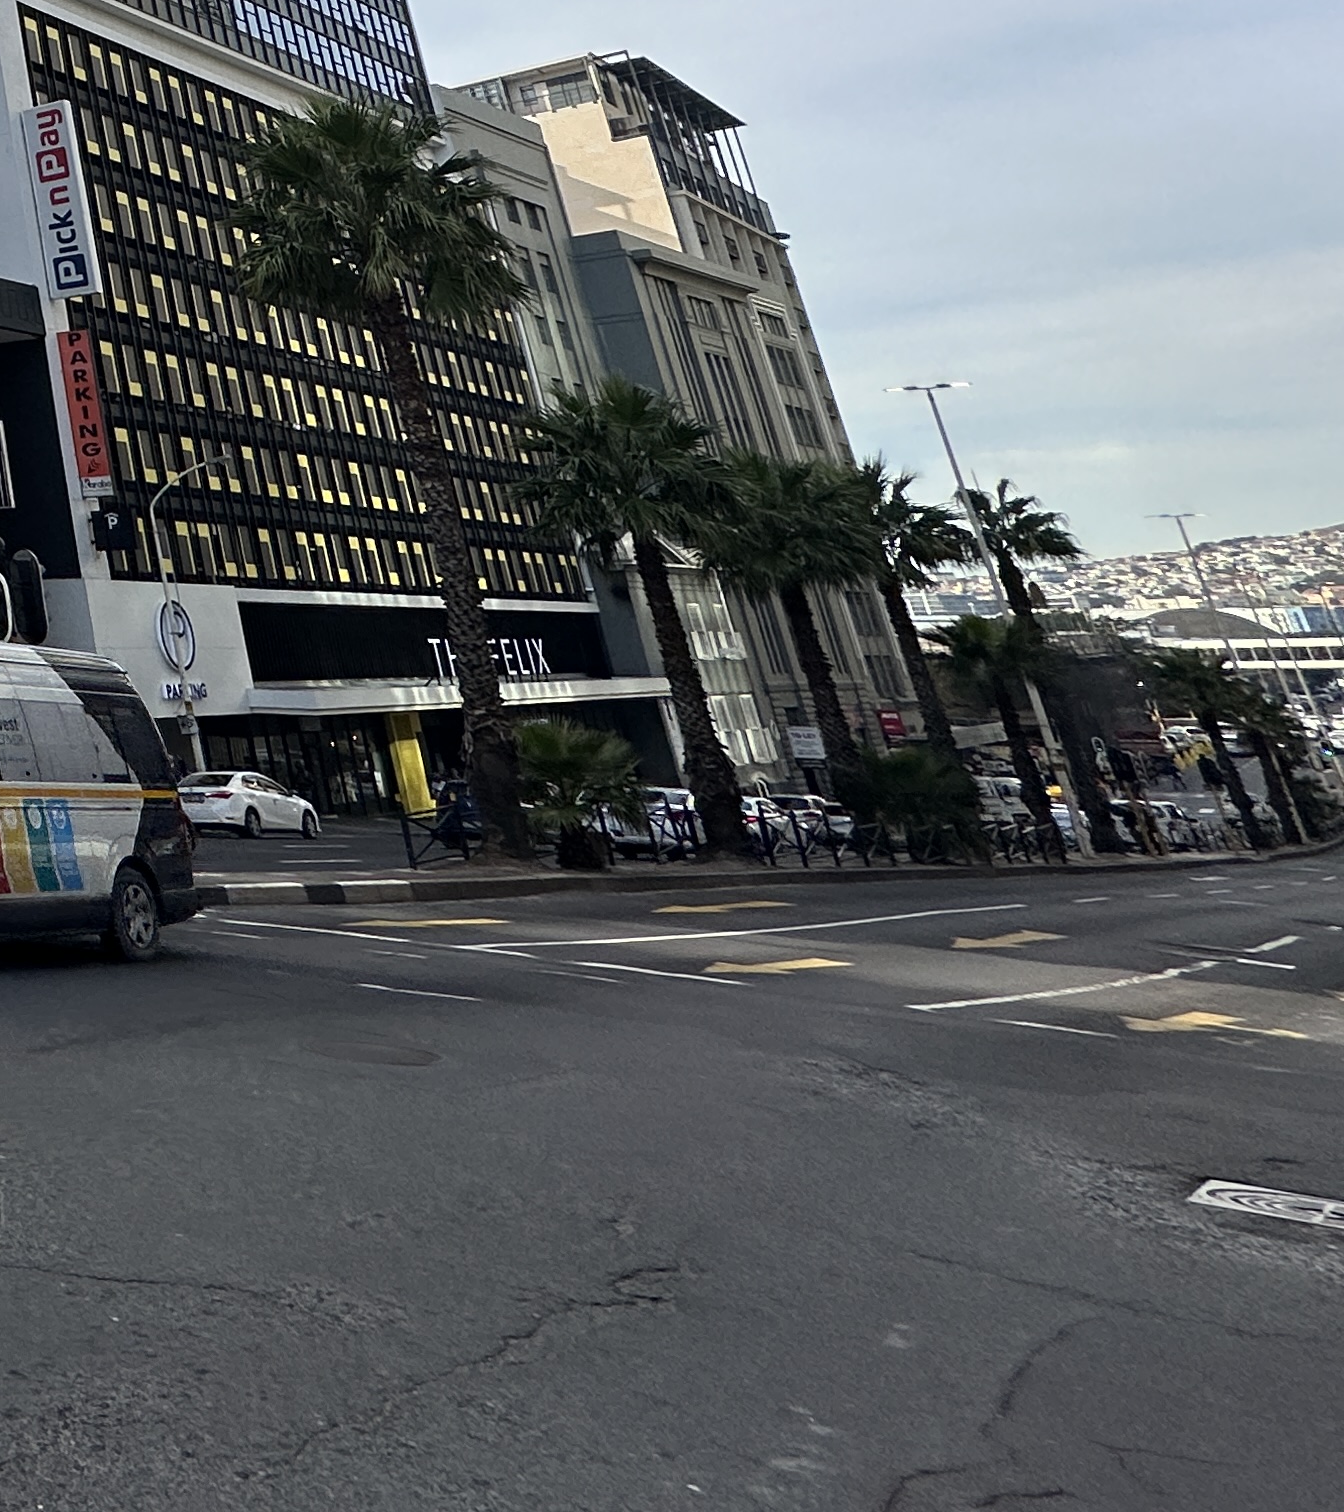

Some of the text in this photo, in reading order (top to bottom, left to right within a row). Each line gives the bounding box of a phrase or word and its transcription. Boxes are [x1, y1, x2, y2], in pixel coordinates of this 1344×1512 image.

[36, 108, 86, 288] Pick n Pay
[67, 332, 102, 457] PARKING
